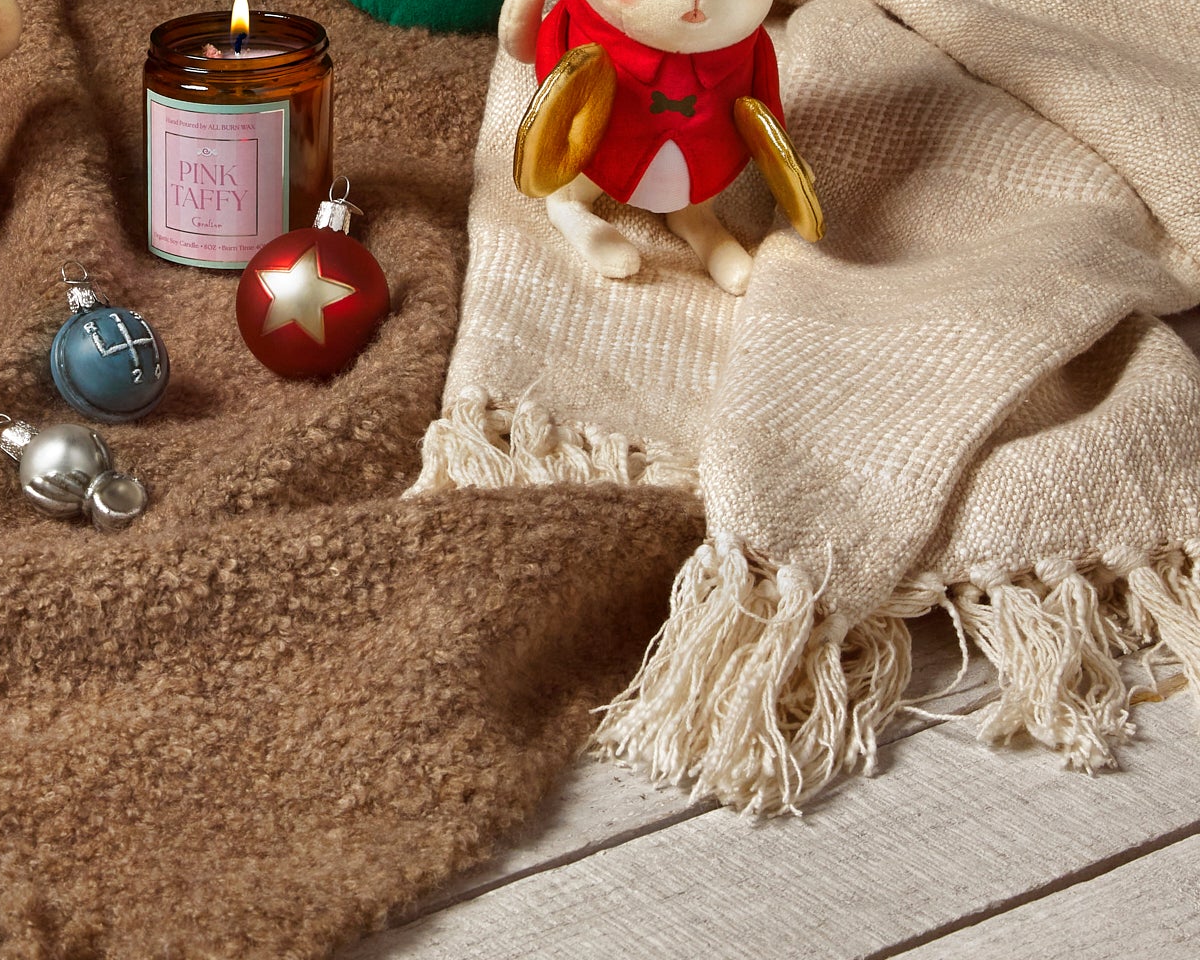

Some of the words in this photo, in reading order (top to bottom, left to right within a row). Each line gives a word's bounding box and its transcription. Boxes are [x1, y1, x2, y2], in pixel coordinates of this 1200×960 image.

[199, 122, 207, 130] by
[179, 160, 239, 186] PINK
[171, 183, 249, 211] TAFFY
[132, 368, 144, 384] 2
